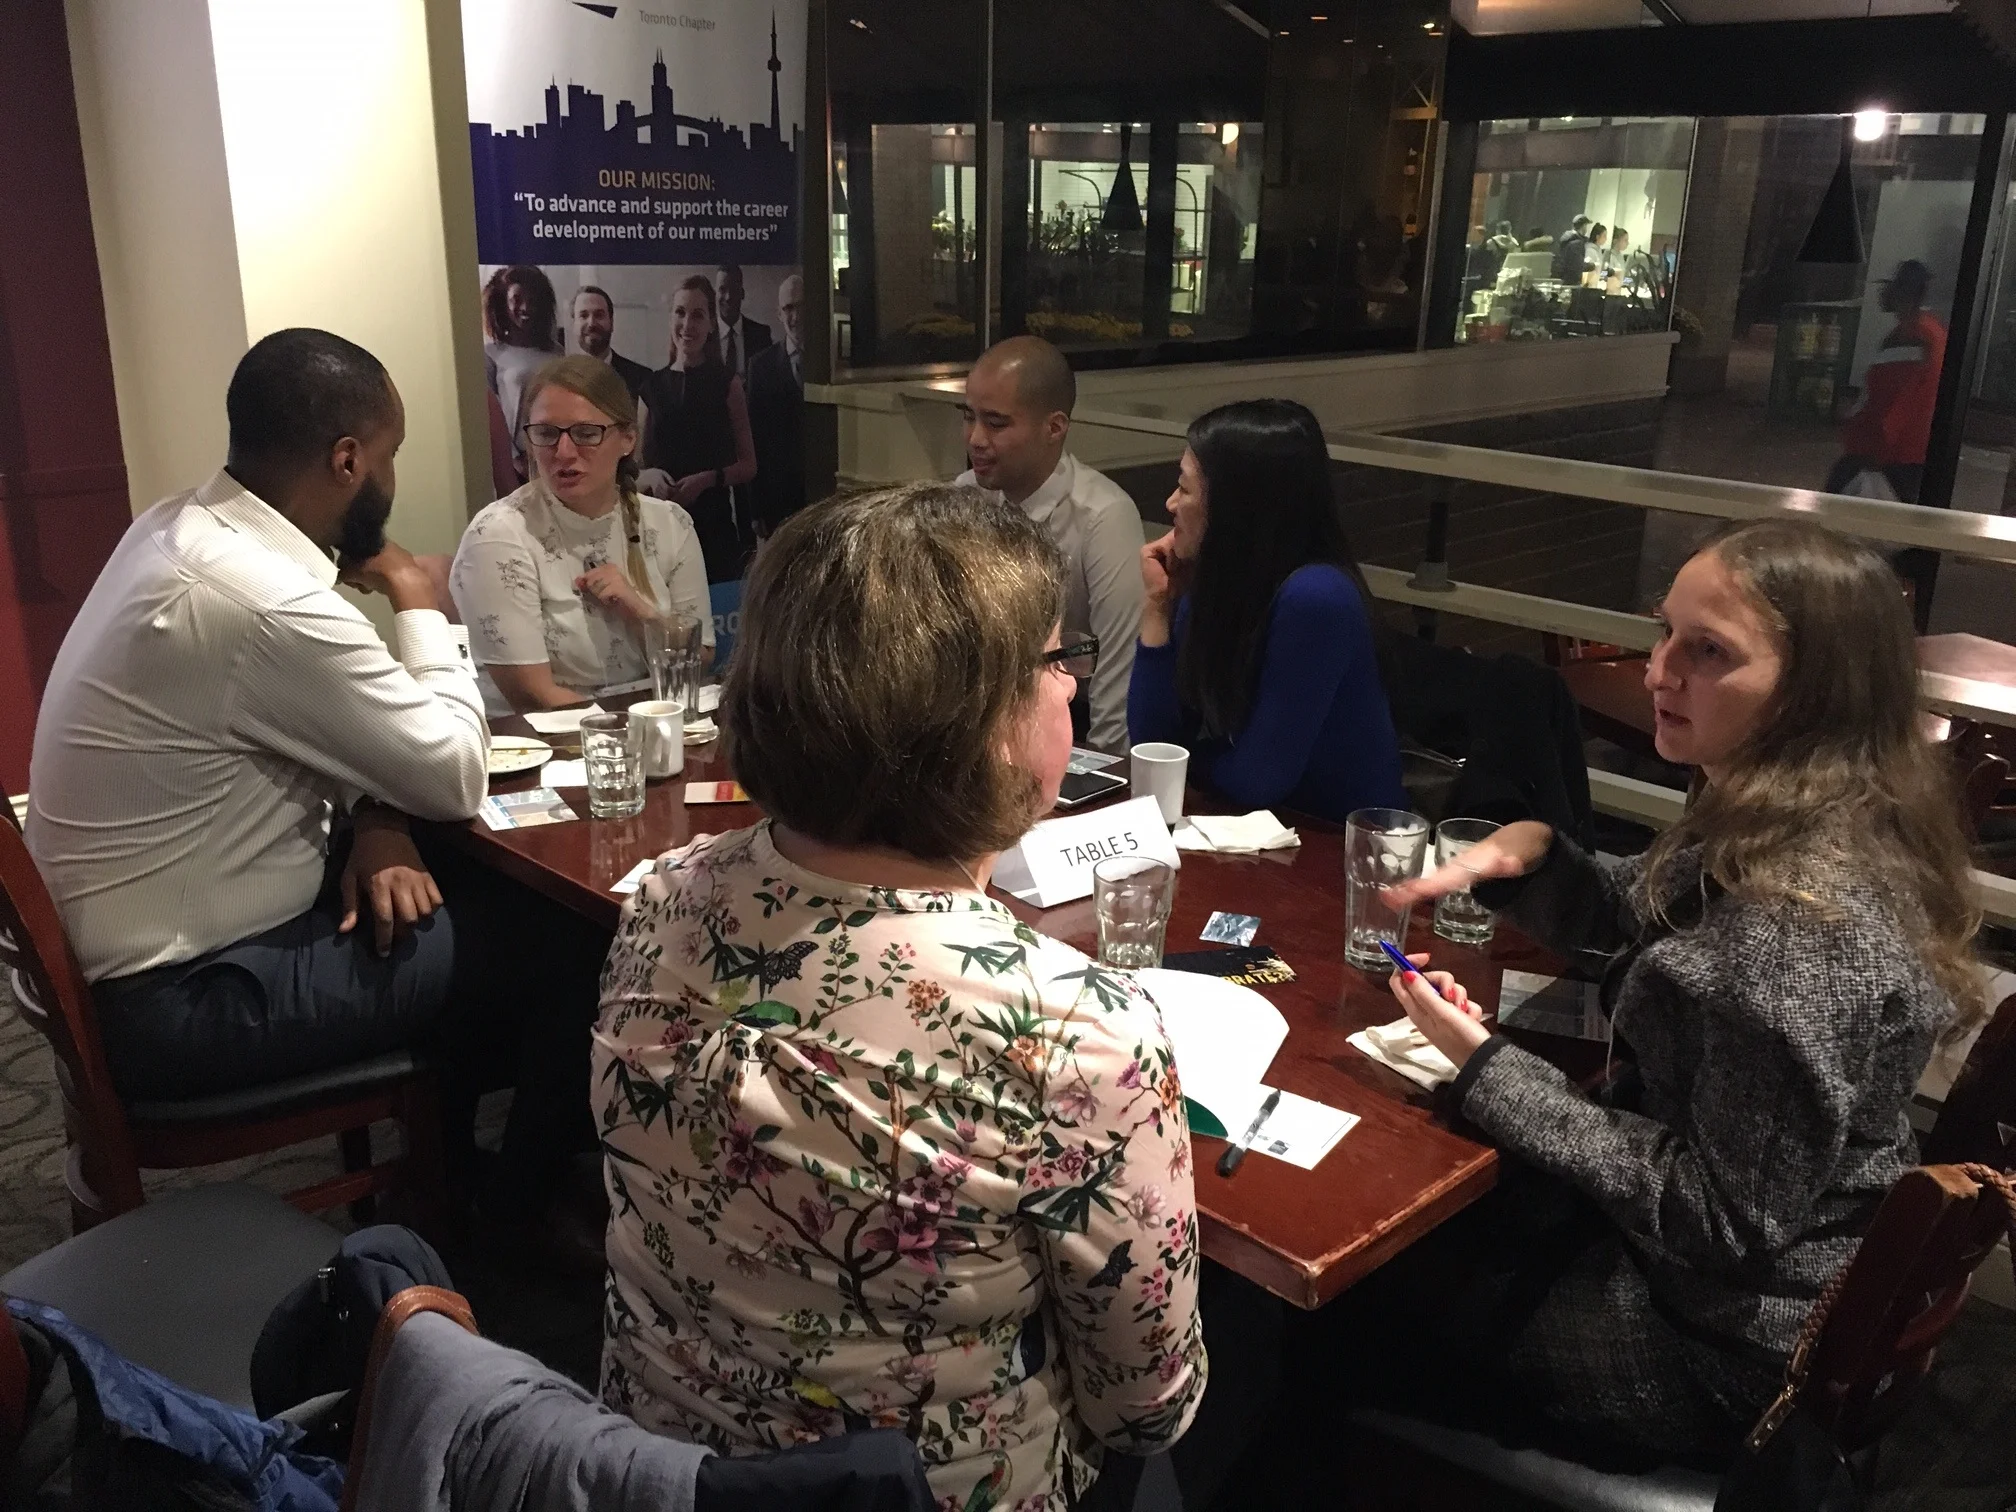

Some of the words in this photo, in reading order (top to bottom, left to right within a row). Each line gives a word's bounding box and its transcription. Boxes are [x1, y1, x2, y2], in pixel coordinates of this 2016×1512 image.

[639, 9, 676, 26] Toronto
[680, 14, 716, 31] Chapter
[599, 169, 636, 188] OUR
[641, 171, 716, 191] MISSION:
[514, 192, 545, 212] “To
[549, 193, 616, 213] advance
[620, 195, 650, 214] and
[653, 200, 713, 219] support
[716, 199, 740, 216] the
[744, 203, 788, 217] career
[533, 219, 643, 243] development
[648, 221, 664, 239] of
[668, 226, 695, 240] our
[699, 223, 778, 240] members”
[1060, 836, 1123, 866] TABLE
[1124, 832, 1138, 850] 5
